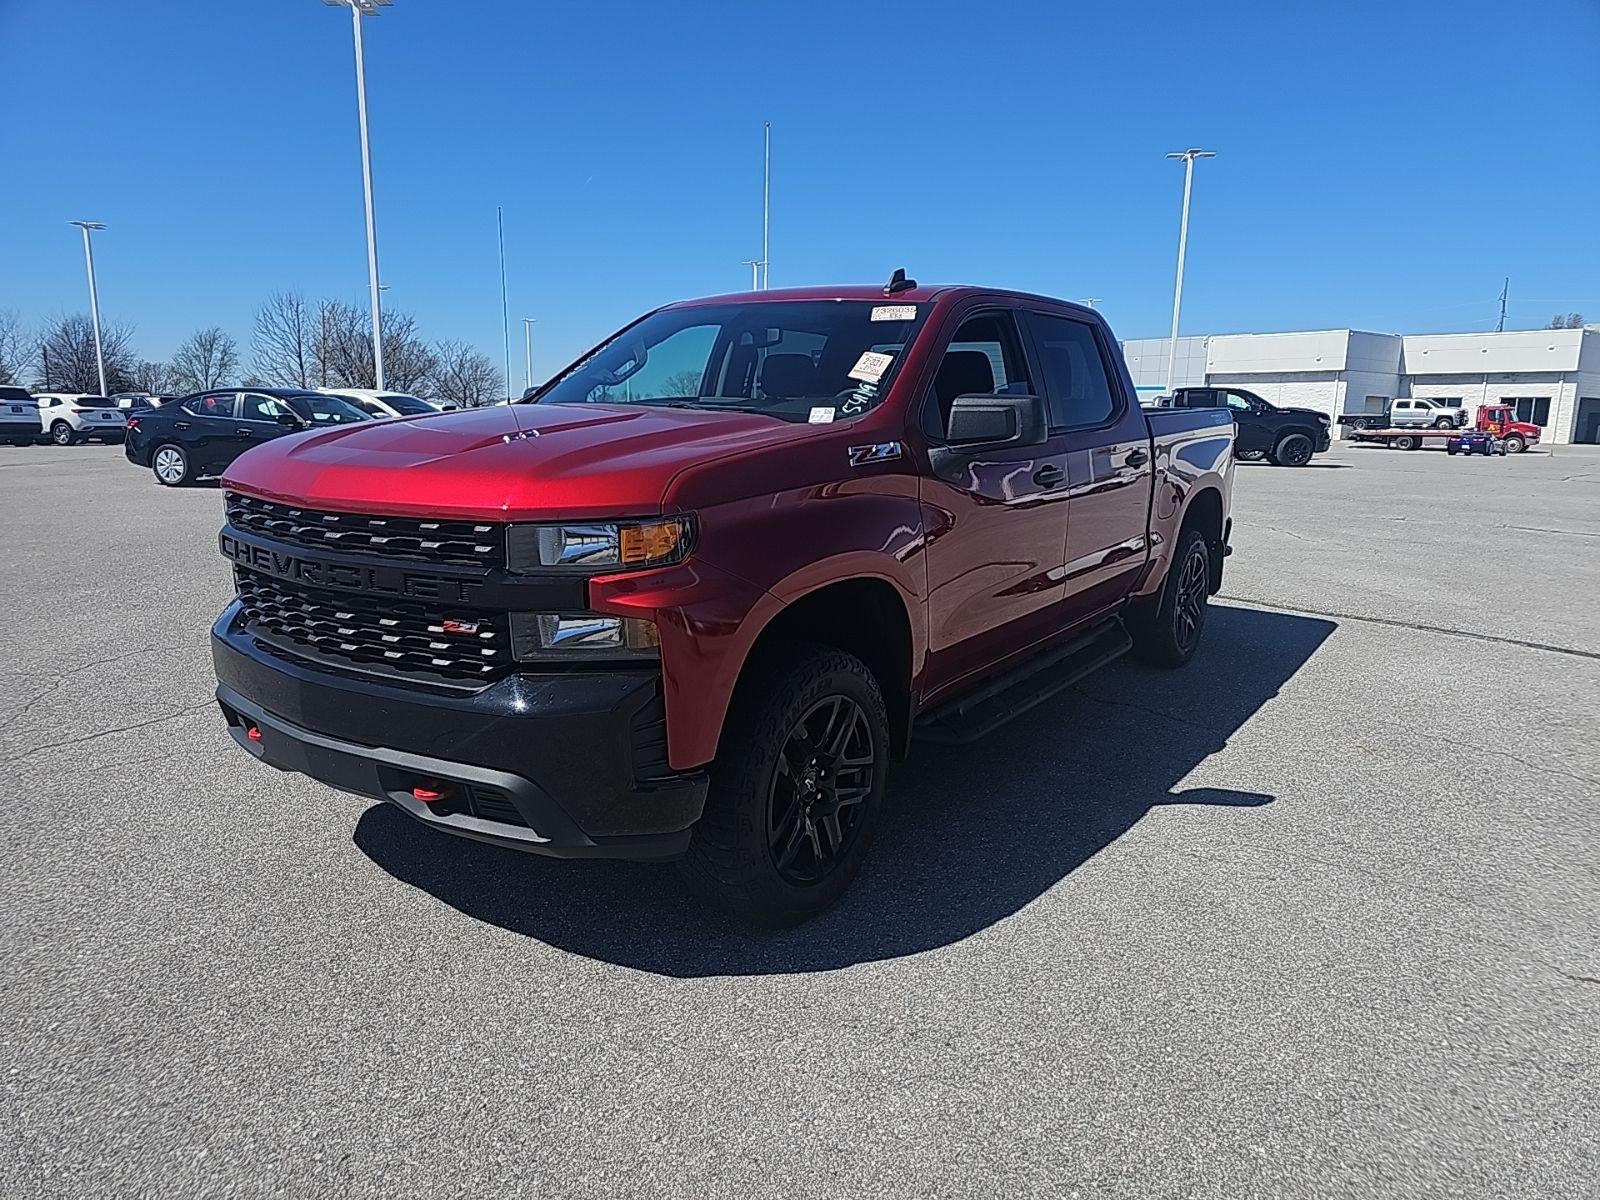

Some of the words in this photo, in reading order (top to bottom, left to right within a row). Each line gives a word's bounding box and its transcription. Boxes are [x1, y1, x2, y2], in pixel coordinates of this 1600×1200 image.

[848, 442, 901, 467] Z71
[221, 535, 483, 601] CHEVROLET
[443, 619, 480, 634] Z71
